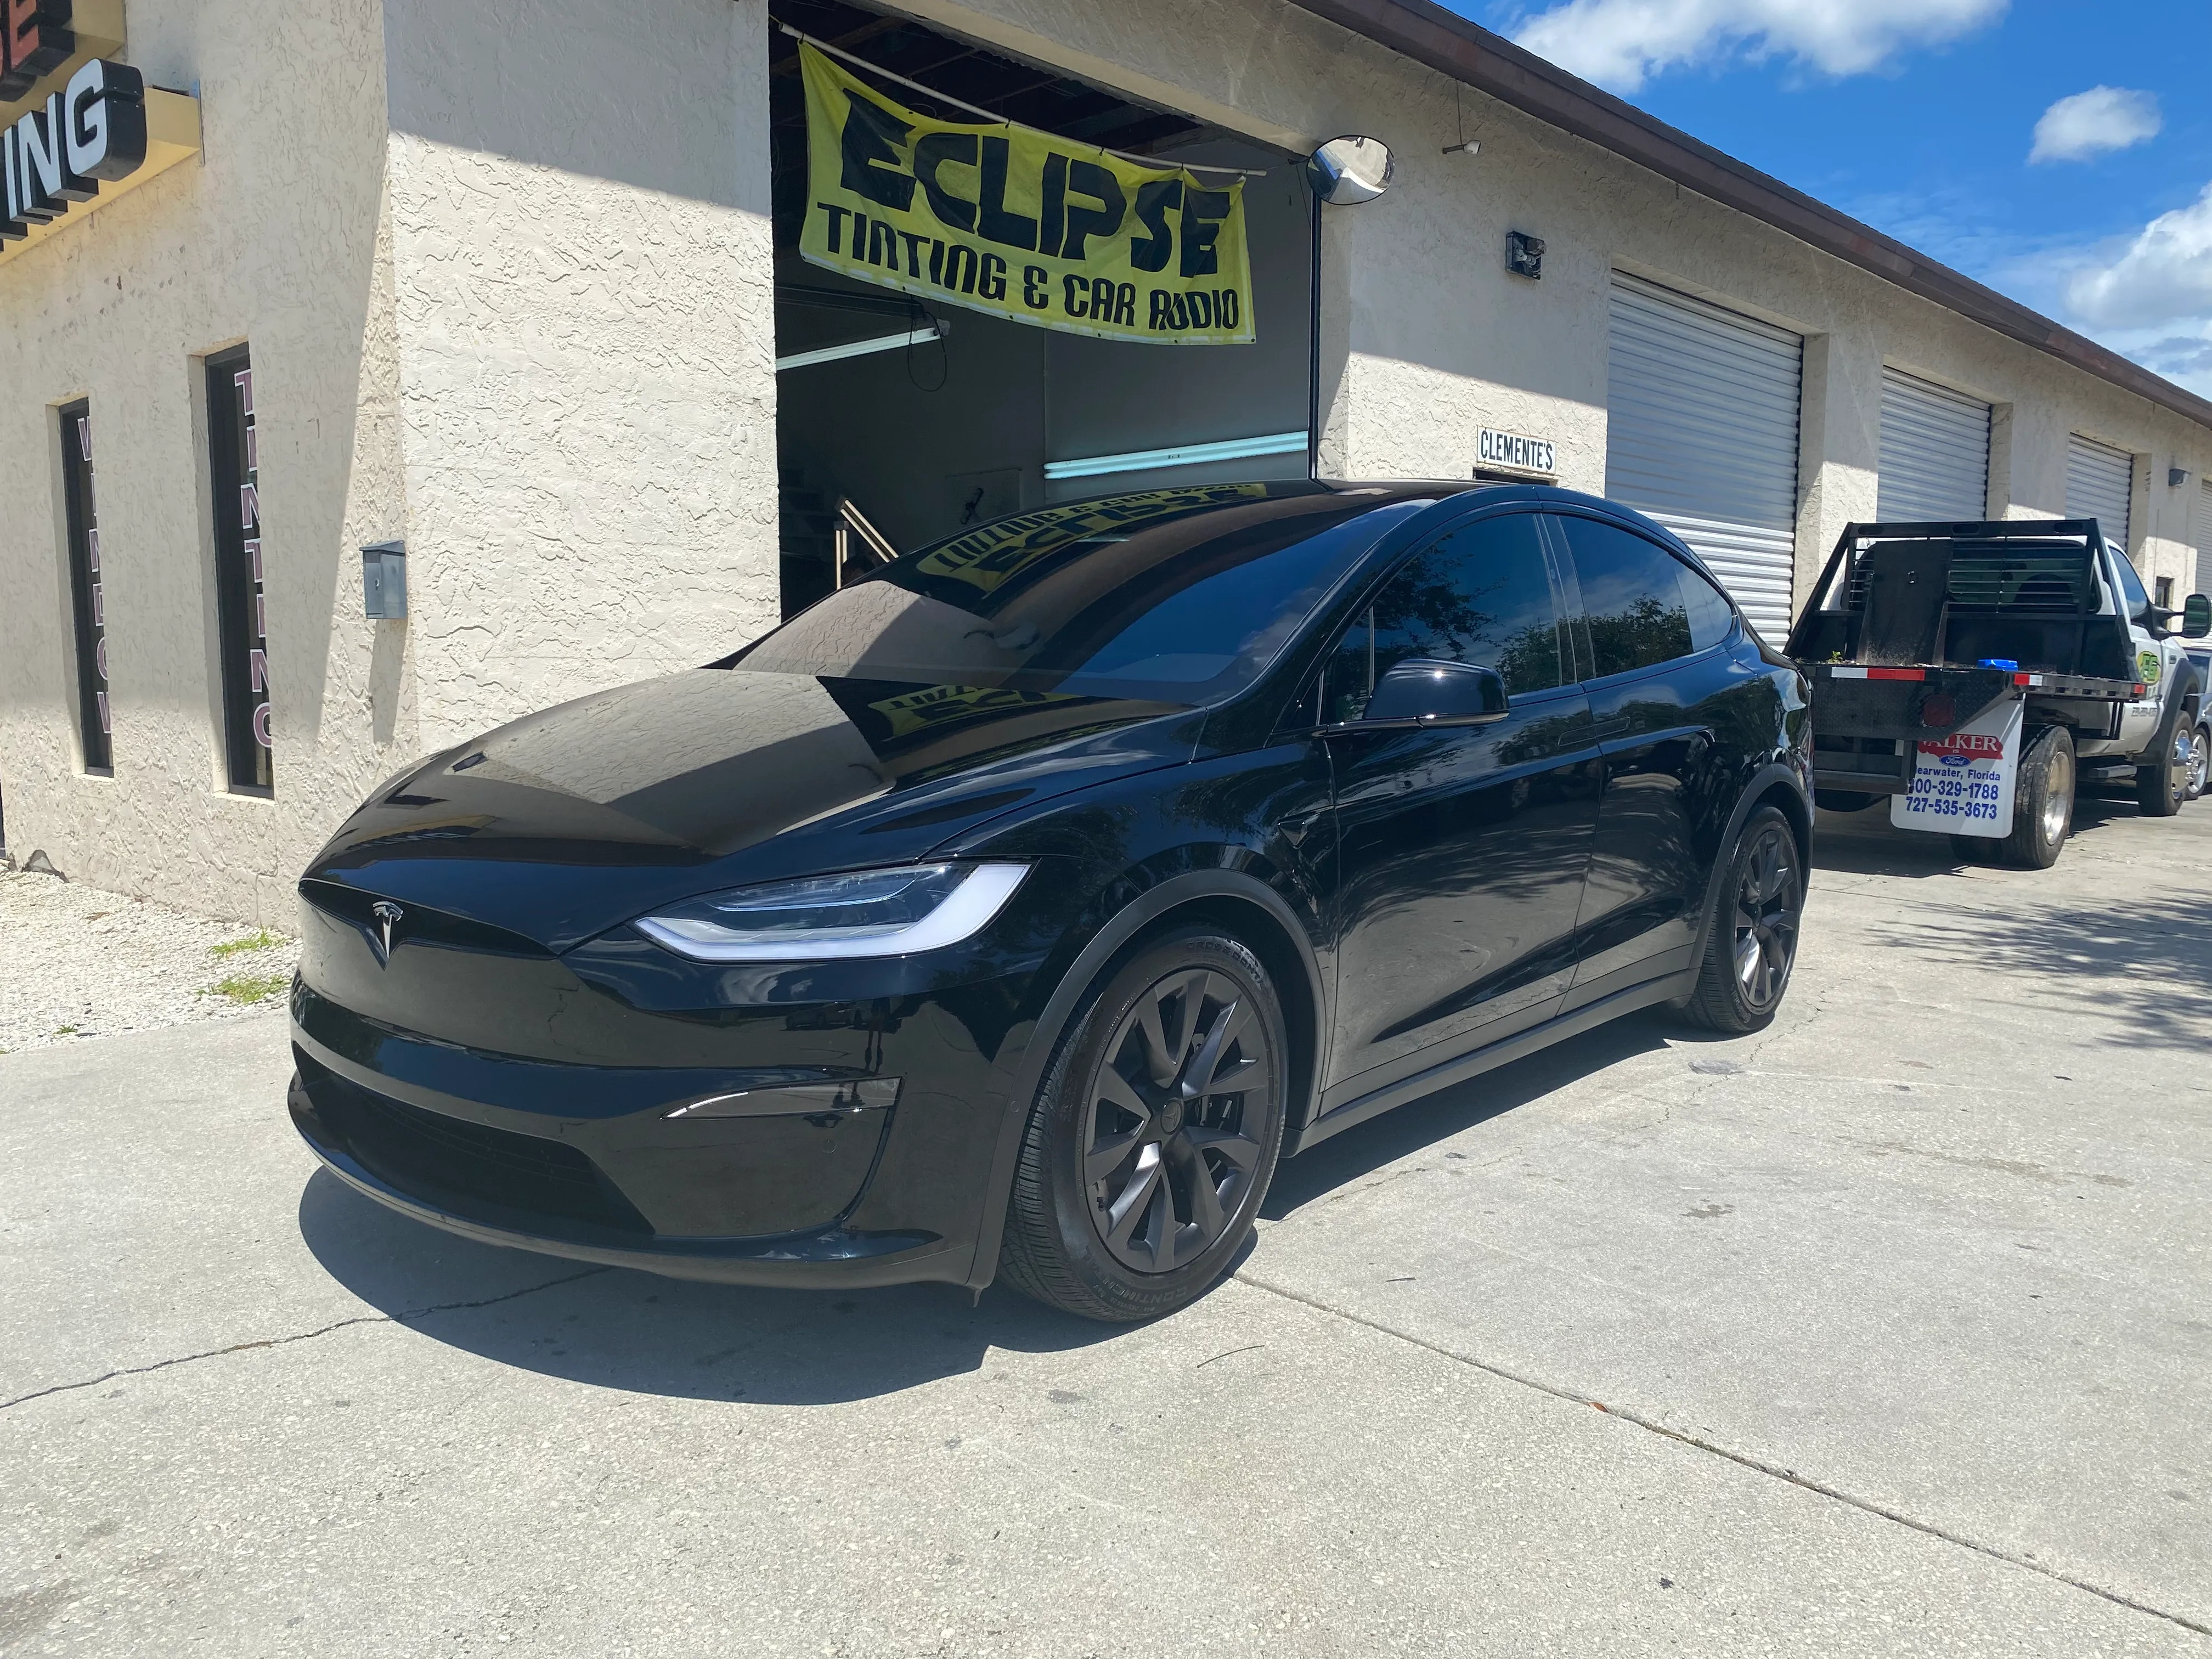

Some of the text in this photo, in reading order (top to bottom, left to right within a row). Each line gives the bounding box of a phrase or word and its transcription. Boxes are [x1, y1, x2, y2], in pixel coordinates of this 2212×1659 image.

[840, 88, 1231, 278] ECLIPSE
[817, 201, 1239, 331] TINTING & CAR AUDIO
[1481, 430, 1553, 470] CLEMENTE'S
[1967, 769, 2001, 781] Florida
[1906, 796, 1997, 820] 727-535-3673
